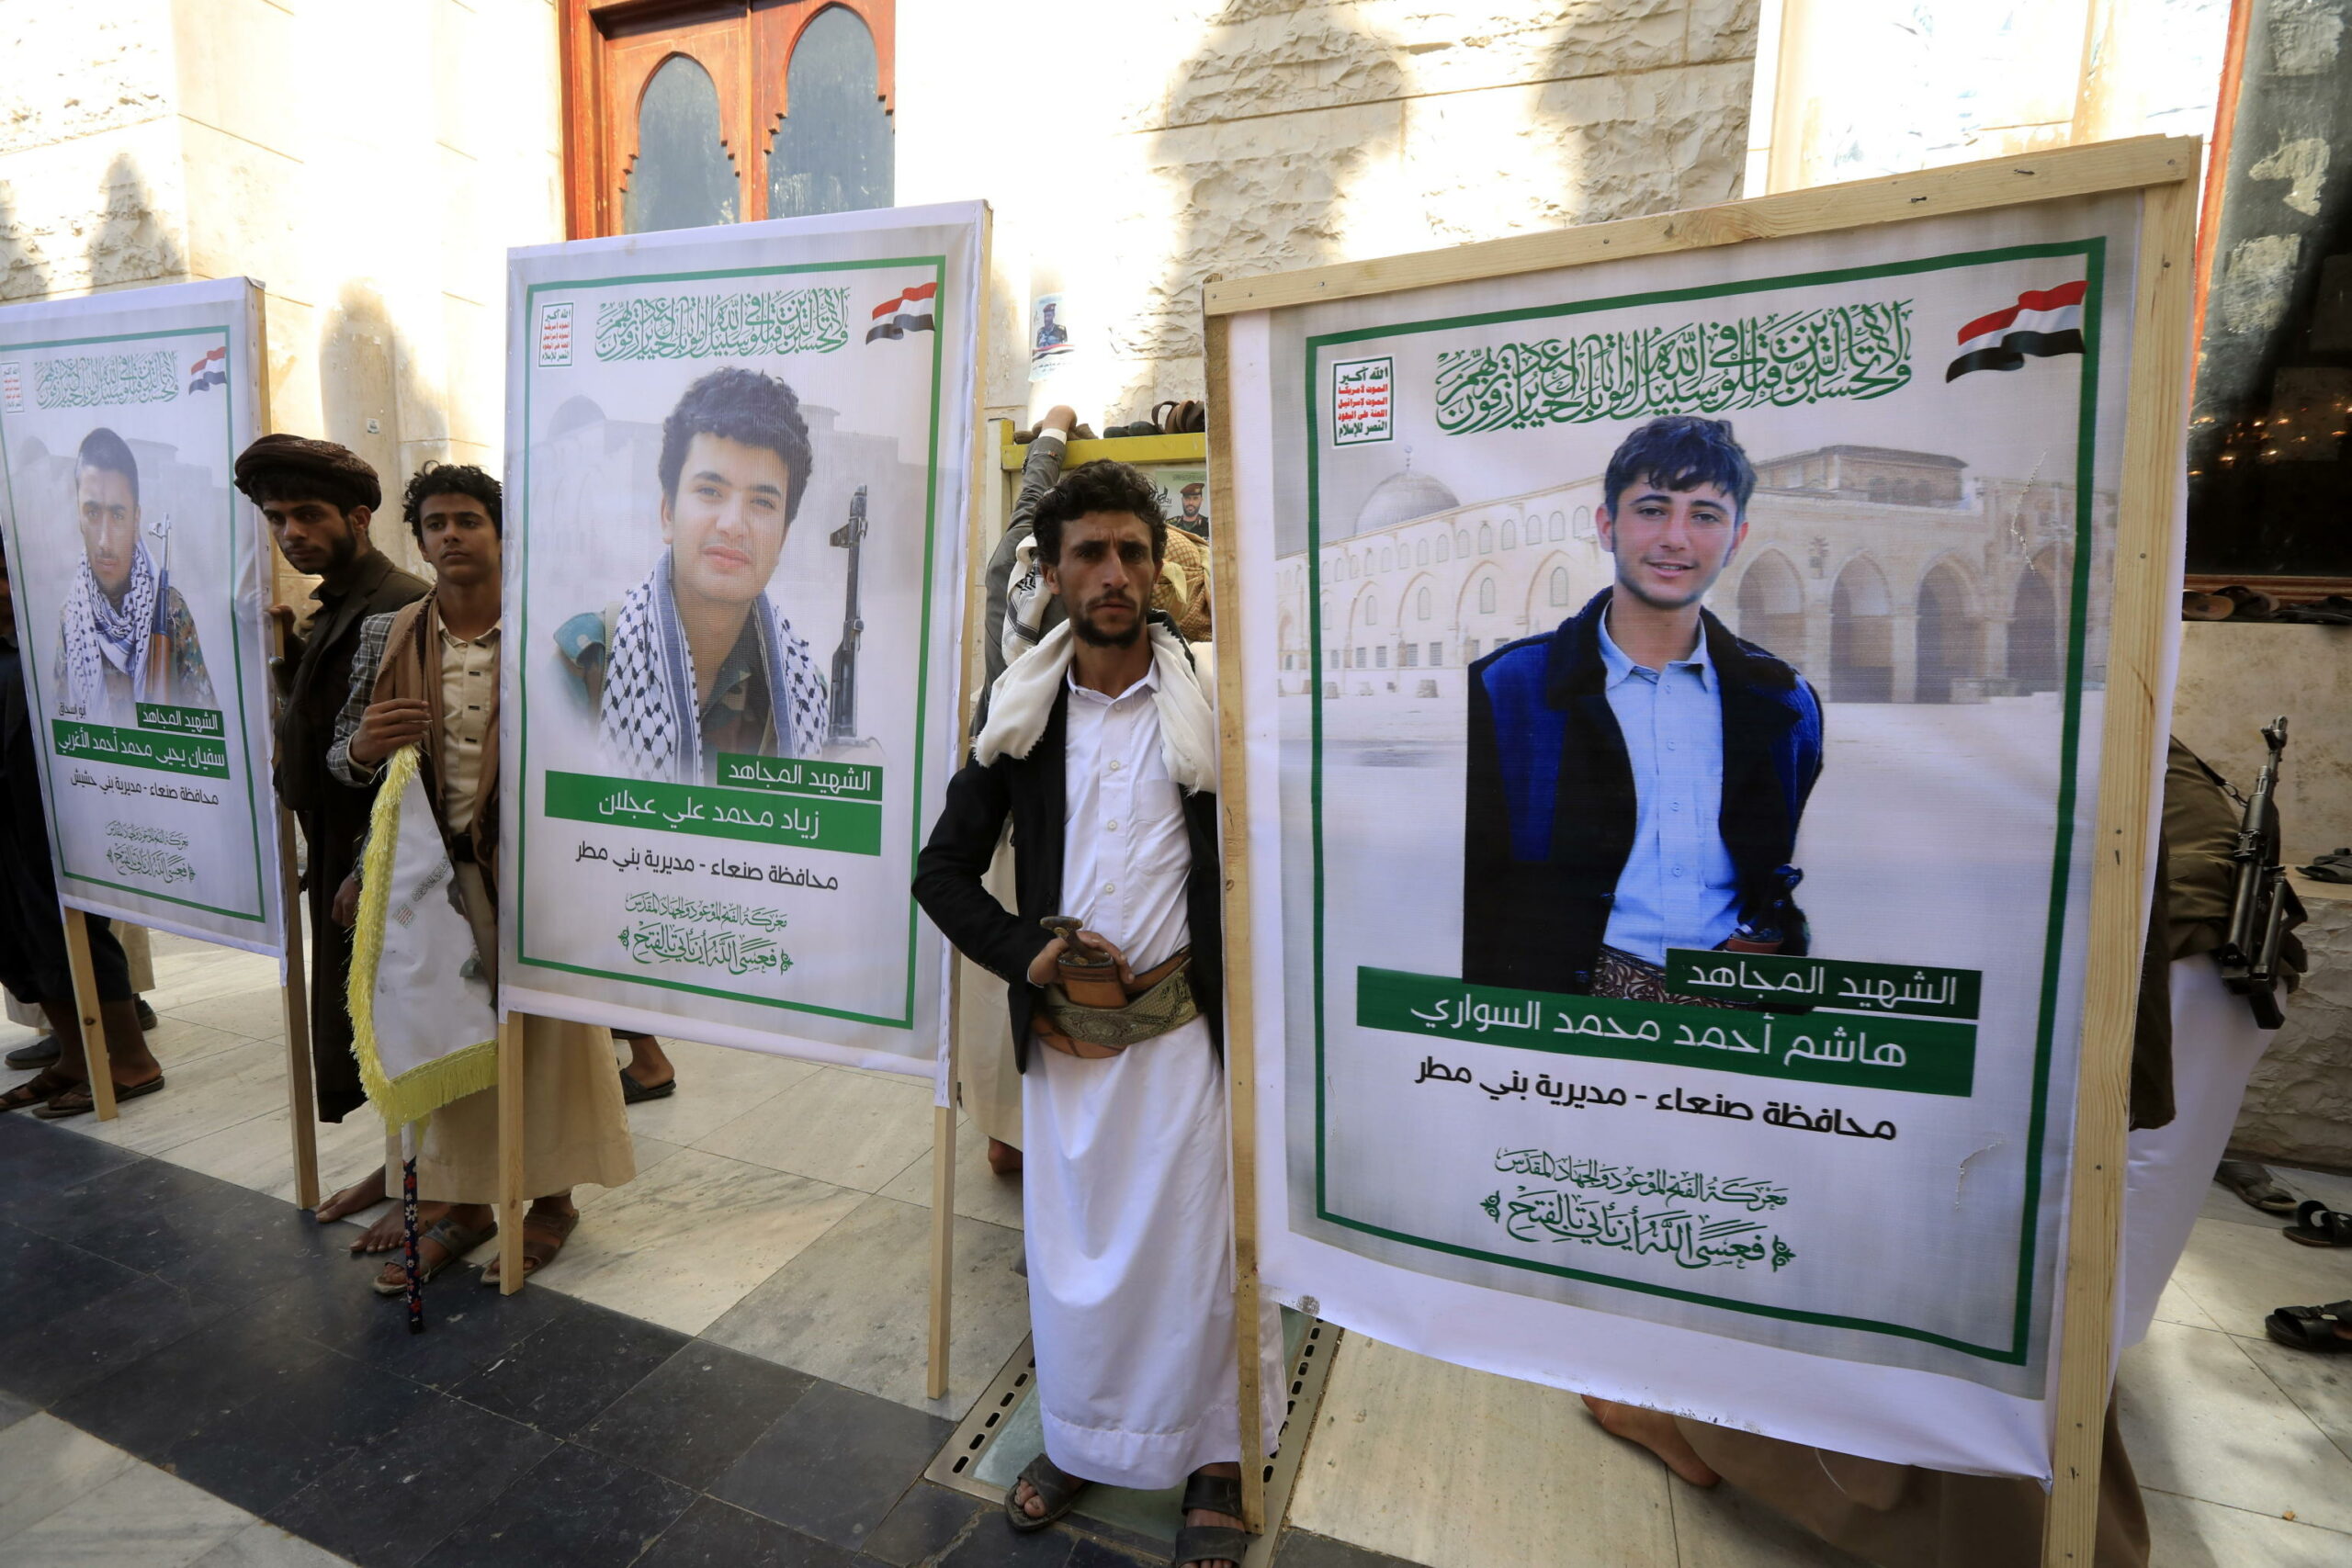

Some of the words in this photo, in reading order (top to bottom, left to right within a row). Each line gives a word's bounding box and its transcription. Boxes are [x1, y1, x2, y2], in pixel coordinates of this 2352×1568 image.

[1339, 367, 1369, 385] أكبر
[1370, 367, 1388, 380] الله
[142, 708, 182, 728] المجاهد
[185, 710, 218, 733] الشهيد
[93, 728, 119, 753] أحمد
[121, 740, 153, 758] محمد
[155, 747, 186, 768] يحيى
[189, 746, 225, 771] سفيان
[100, 775, 114, 795] بني
[115, 776, 142, 796] مديرية
[729, 761, 801, 788] المجاهد
[808, 767, 871, 794] الشهيد
[150, 781, 179, 800] صنعاء
[181, 786, 220, 806] محافظة
[599, 789, 657, 819] عجلان
[662, 796, 706, 829] علي
[712, 805, 774, 828] محمد
[780, 808, 820, 839] زياد
[575, 840, 608, 863] مطر
[612, 847, 641, 873] بني
[644, 849, 695, 875] مديرية
[711, 859, 763, 881] صنعاء
[769, 864, 838, 891] محافظة
[1688, 962, 1825, 998] المجاهد
[1838, 971, 1958, 1009] الشهيد
[1411, 994, 1541, 1032] السواري
[1554, 1012, 1660, 1042] محمد
[1674, 1012, 1775, 1055] أحمد
[1783, 1026, 1906, 1066] هاشم
[1414, 1055, 1473, 1084] مطر
[1479, 1070, 1528, 1101] بني
[1536, 1073, 1627, 1109] مديرية
[1656, 1087, 1754, 1122] صنعاء
[1763, 1100, 1896, 1141] محافظة
